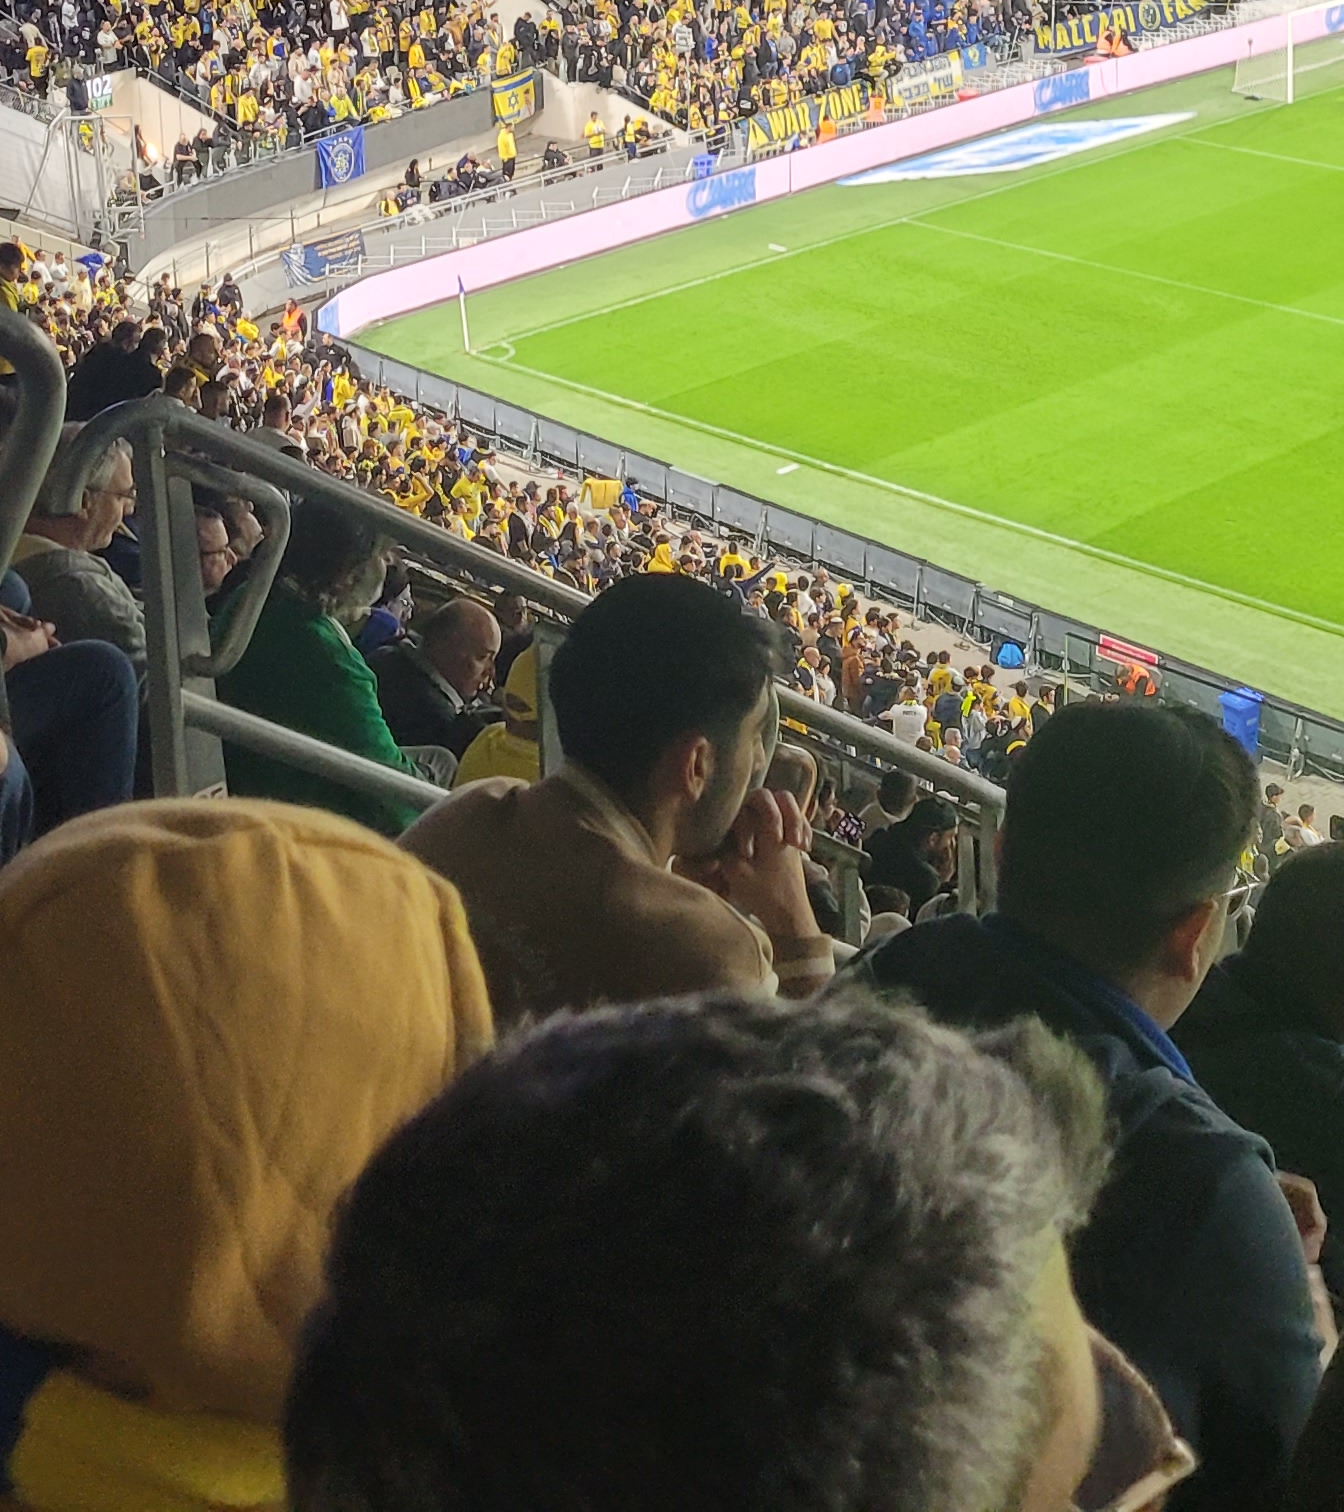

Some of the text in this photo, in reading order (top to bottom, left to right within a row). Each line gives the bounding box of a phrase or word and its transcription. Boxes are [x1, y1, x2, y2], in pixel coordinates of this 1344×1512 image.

[1034, 5, 1137, 51] MACCABI
[86, 74, 112, 100] 102
[766, 83, 869, 141] WAR ZONE
